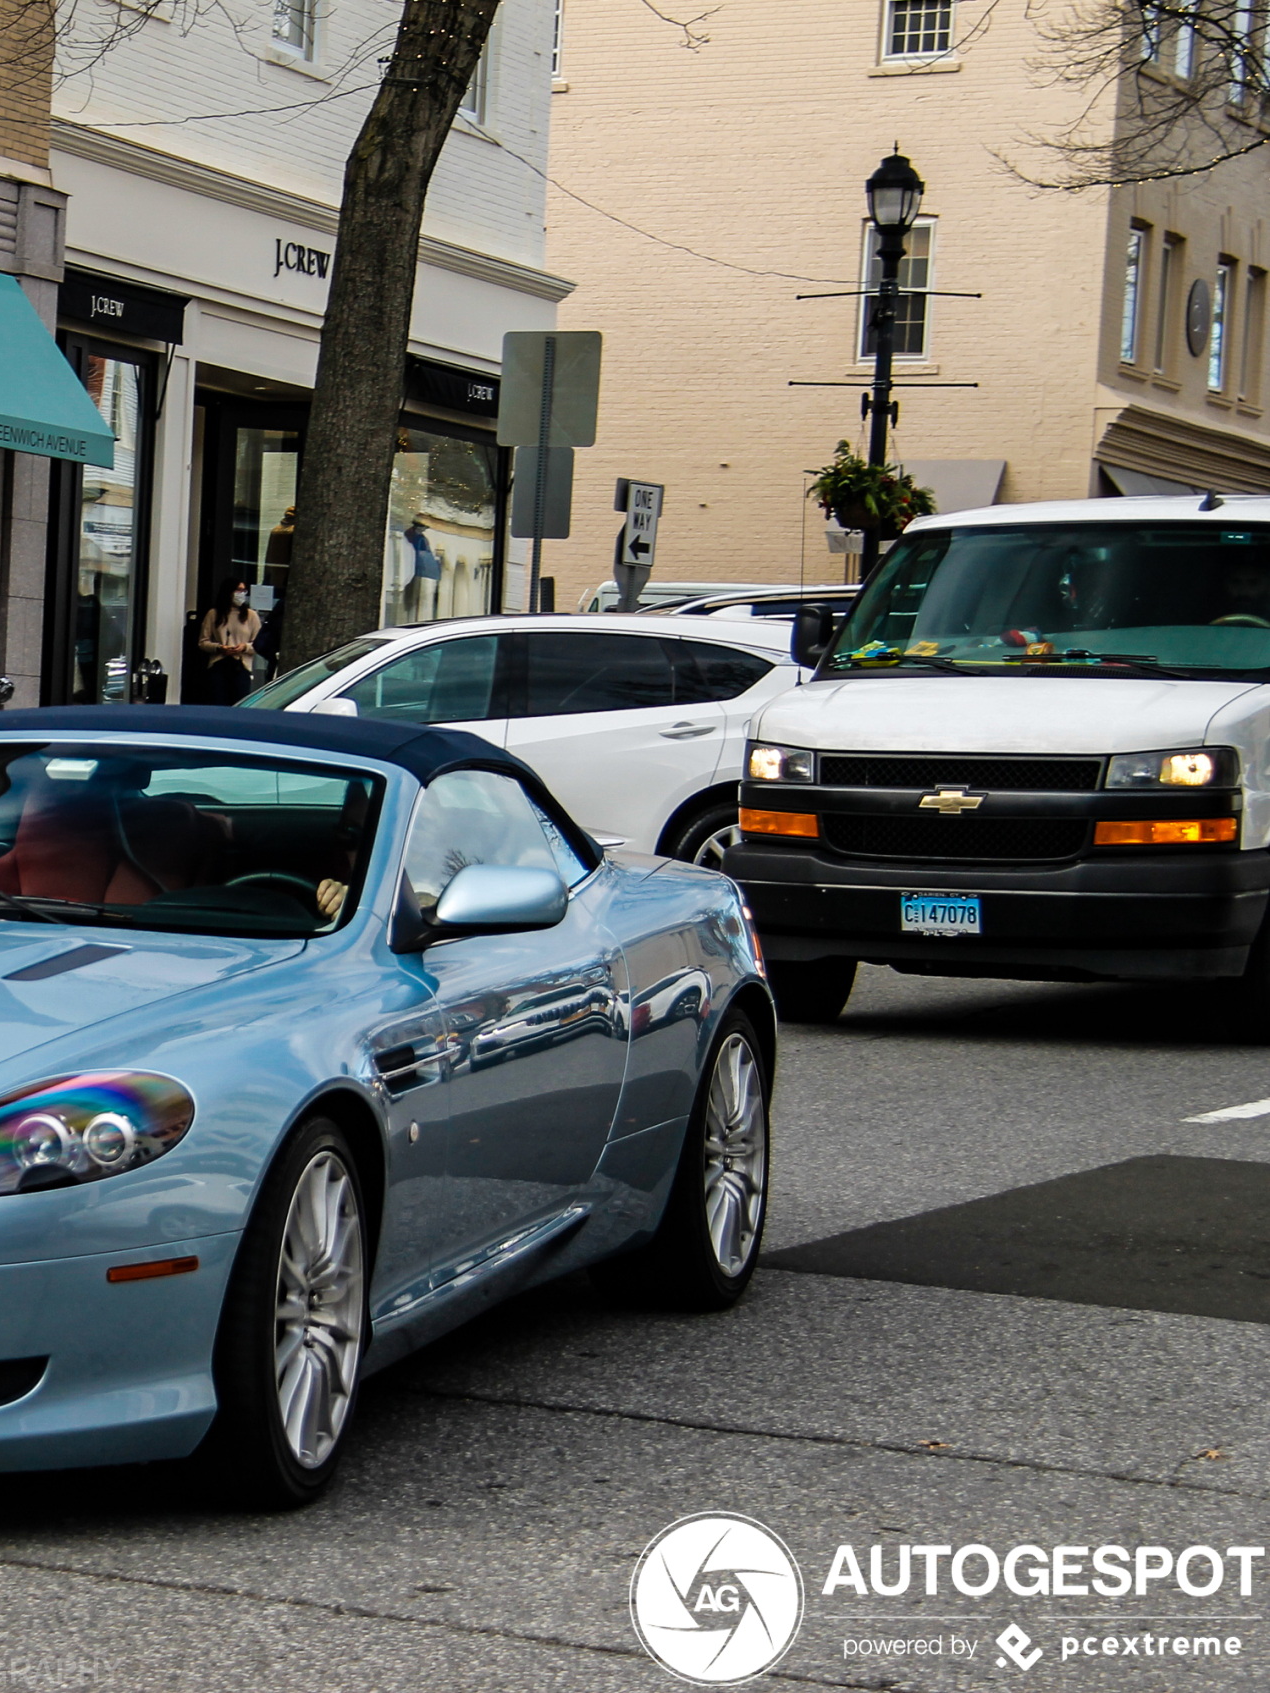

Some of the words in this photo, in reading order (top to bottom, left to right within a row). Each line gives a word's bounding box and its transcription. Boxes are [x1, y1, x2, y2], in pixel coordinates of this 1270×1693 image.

[273, 238, 331, 279] J.CREW
[90, 295, 124, 318] J.CREW
[45, 436, 87, 457] AVENUE
[634, 489, 654, 510] ONE
[633, 512, 652, 532] WAY
